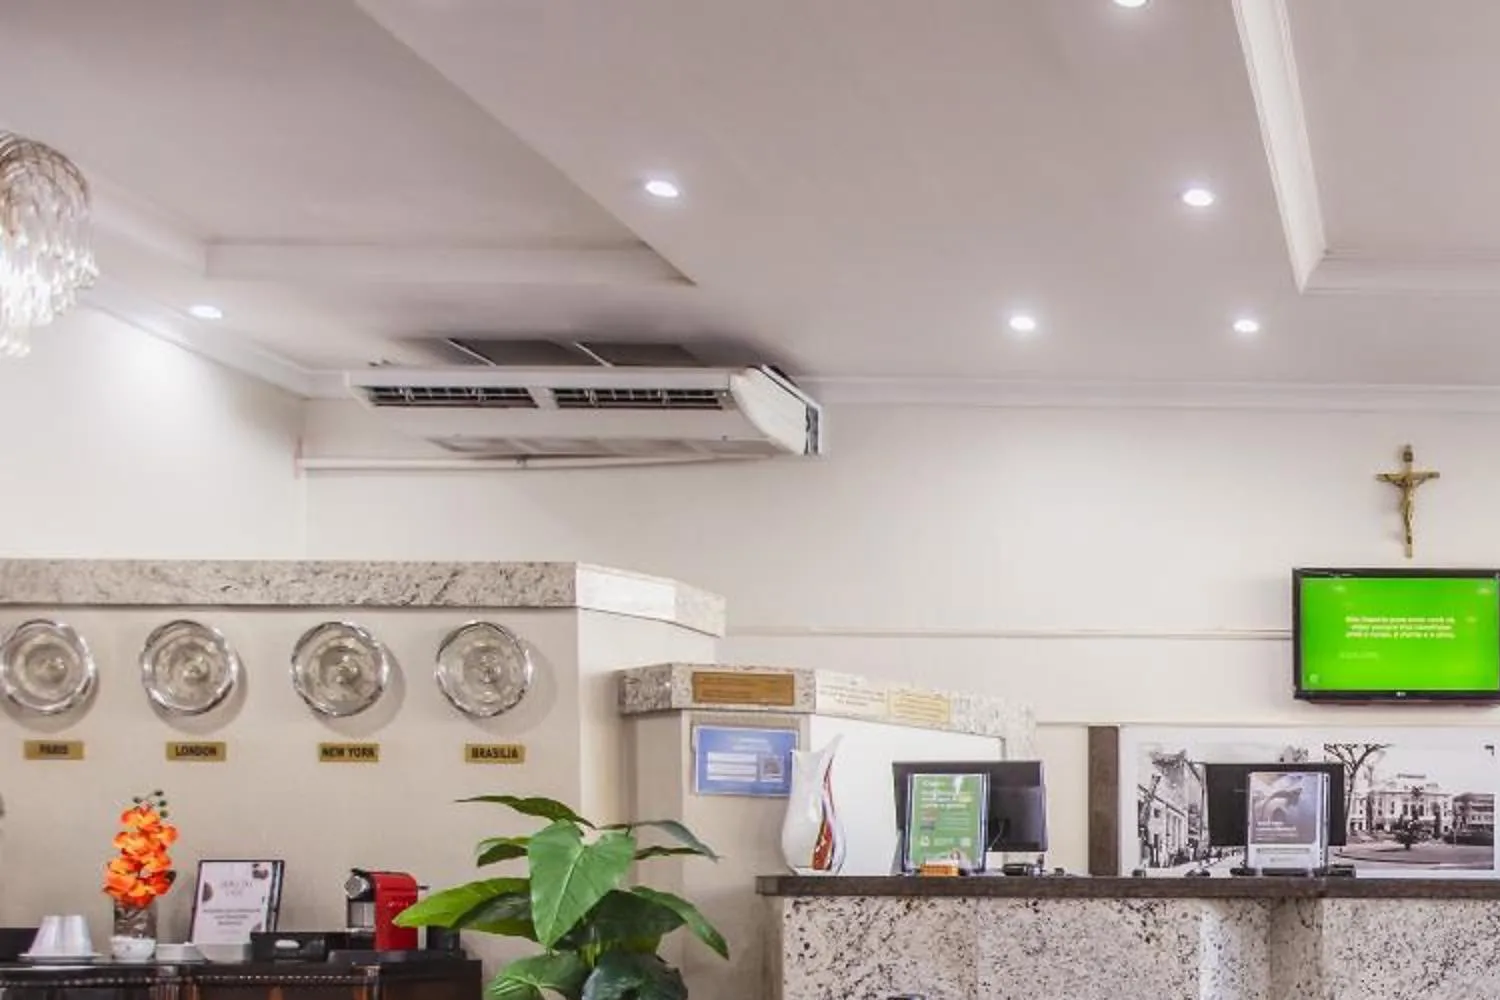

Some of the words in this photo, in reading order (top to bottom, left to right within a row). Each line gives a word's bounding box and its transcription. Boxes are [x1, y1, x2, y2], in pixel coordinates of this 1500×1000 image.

[175, 745, 217, 757] LONDON
[322, 747, 345, 758] NEW
[348, 747, 375, 758] YORK
